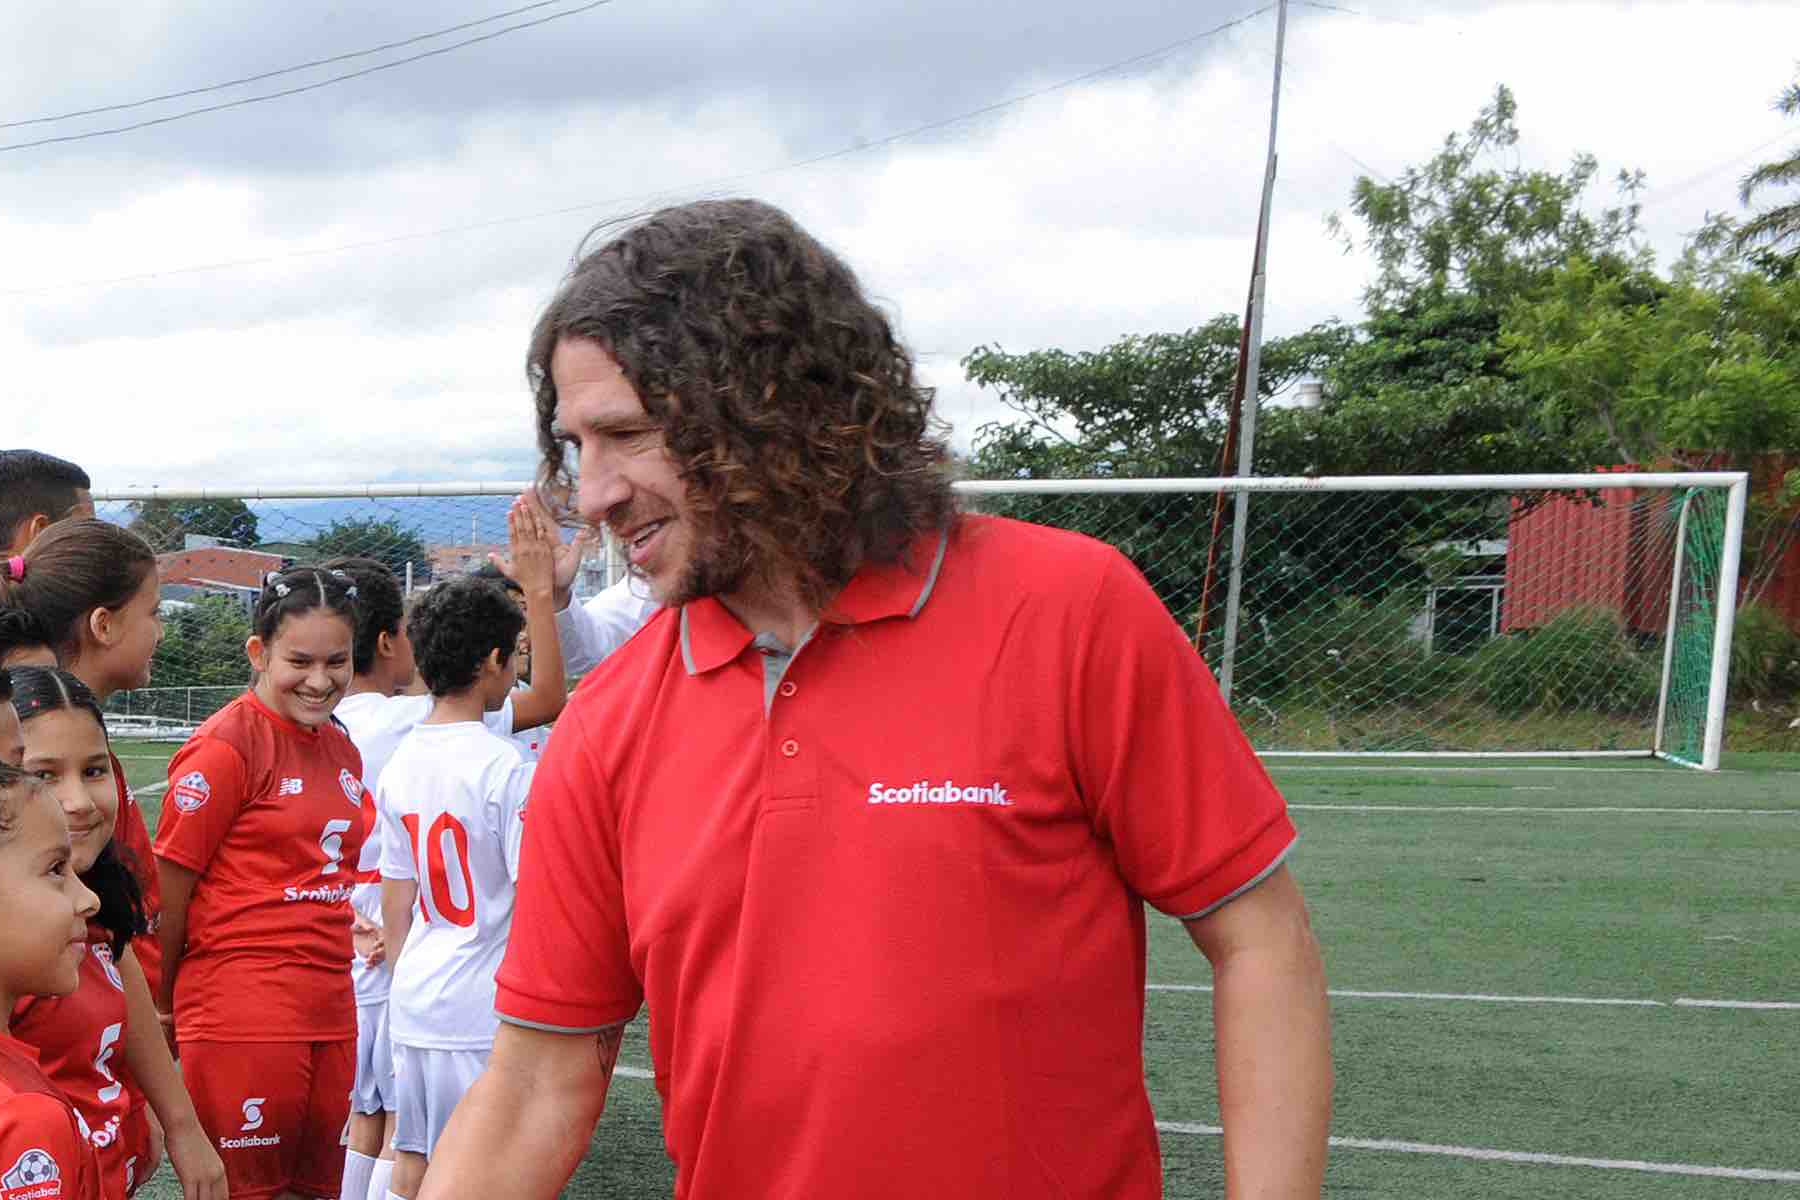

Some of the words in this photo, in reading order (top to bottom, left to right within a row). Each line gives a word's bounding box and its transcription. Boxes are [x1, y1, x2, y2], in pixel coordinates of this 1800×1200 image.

[868, 780, 1008, 806] Scotiabank
[400, 811, 476, 928] 10
[220, 1134, 280, 1149] Scotiabank
